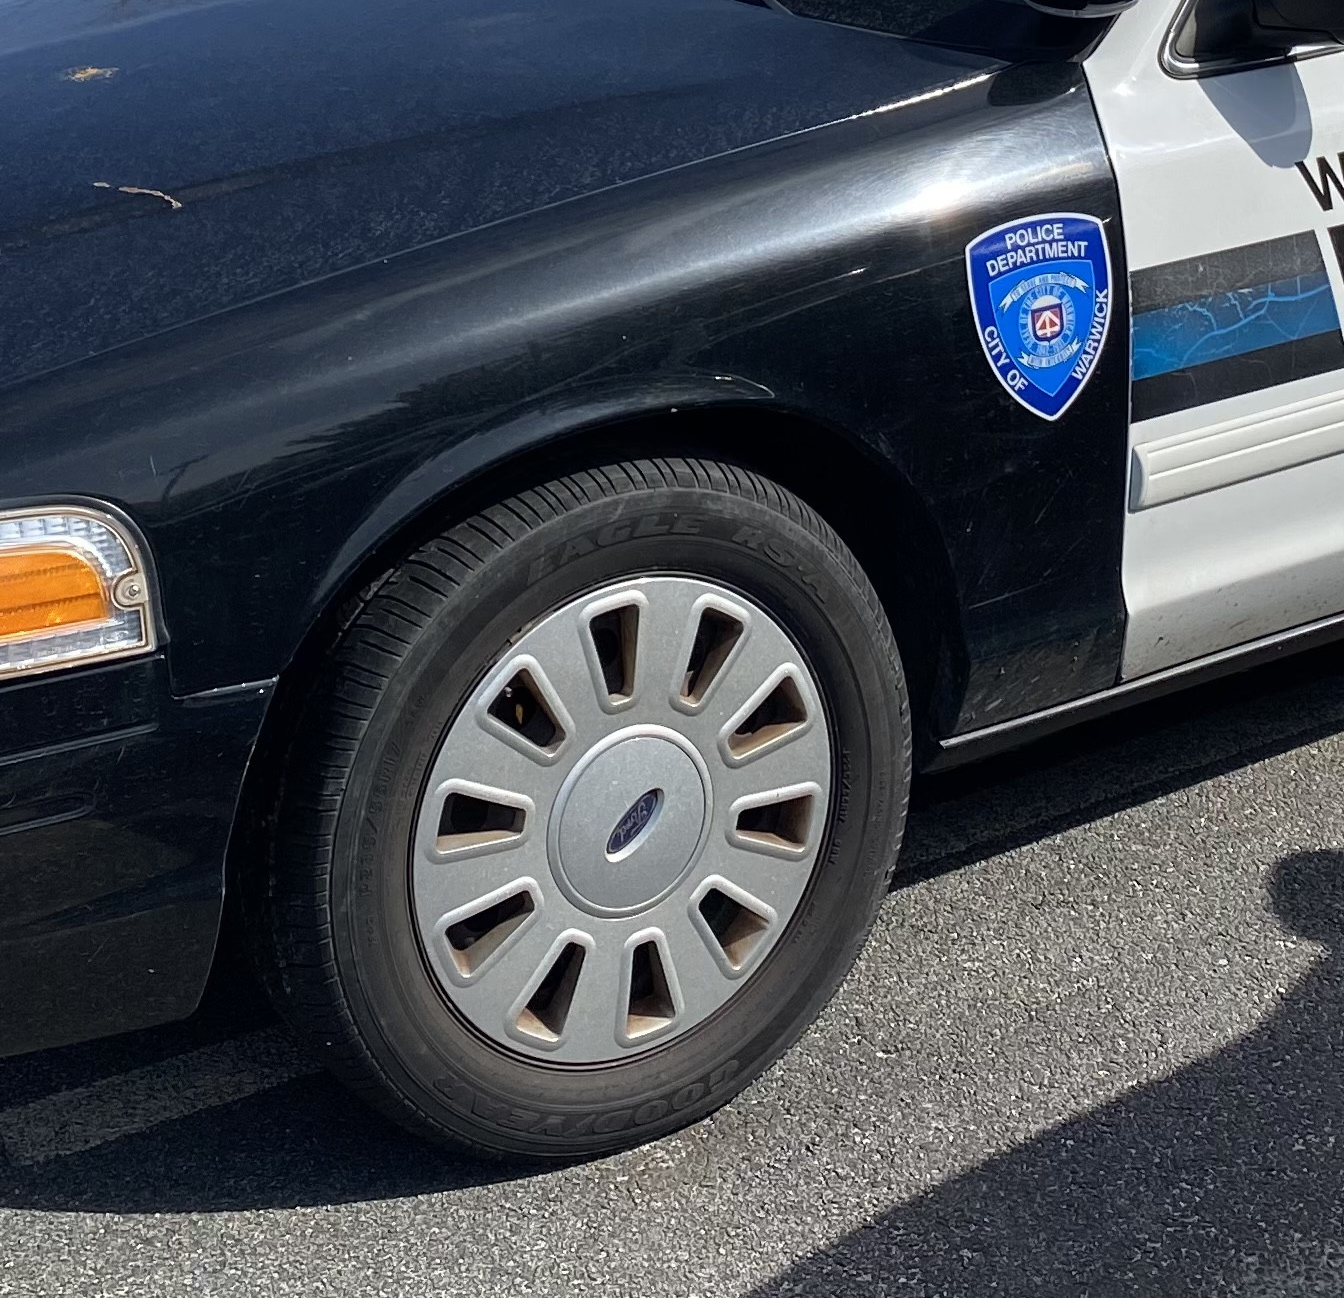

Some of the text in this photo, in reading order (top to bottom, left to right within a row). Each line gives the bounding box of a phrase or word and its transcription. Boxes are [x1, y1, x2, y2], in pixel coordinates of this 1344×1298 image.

[985, 241, 1089, 277] DEPARTMENT
[1004, 223, 1065, 250] POLICE
[984, 288, 1108, 391] CITY OF WARWICK
[526, 515, 705, 586] EAGLE
[612, 798, 651, 844] Ford
